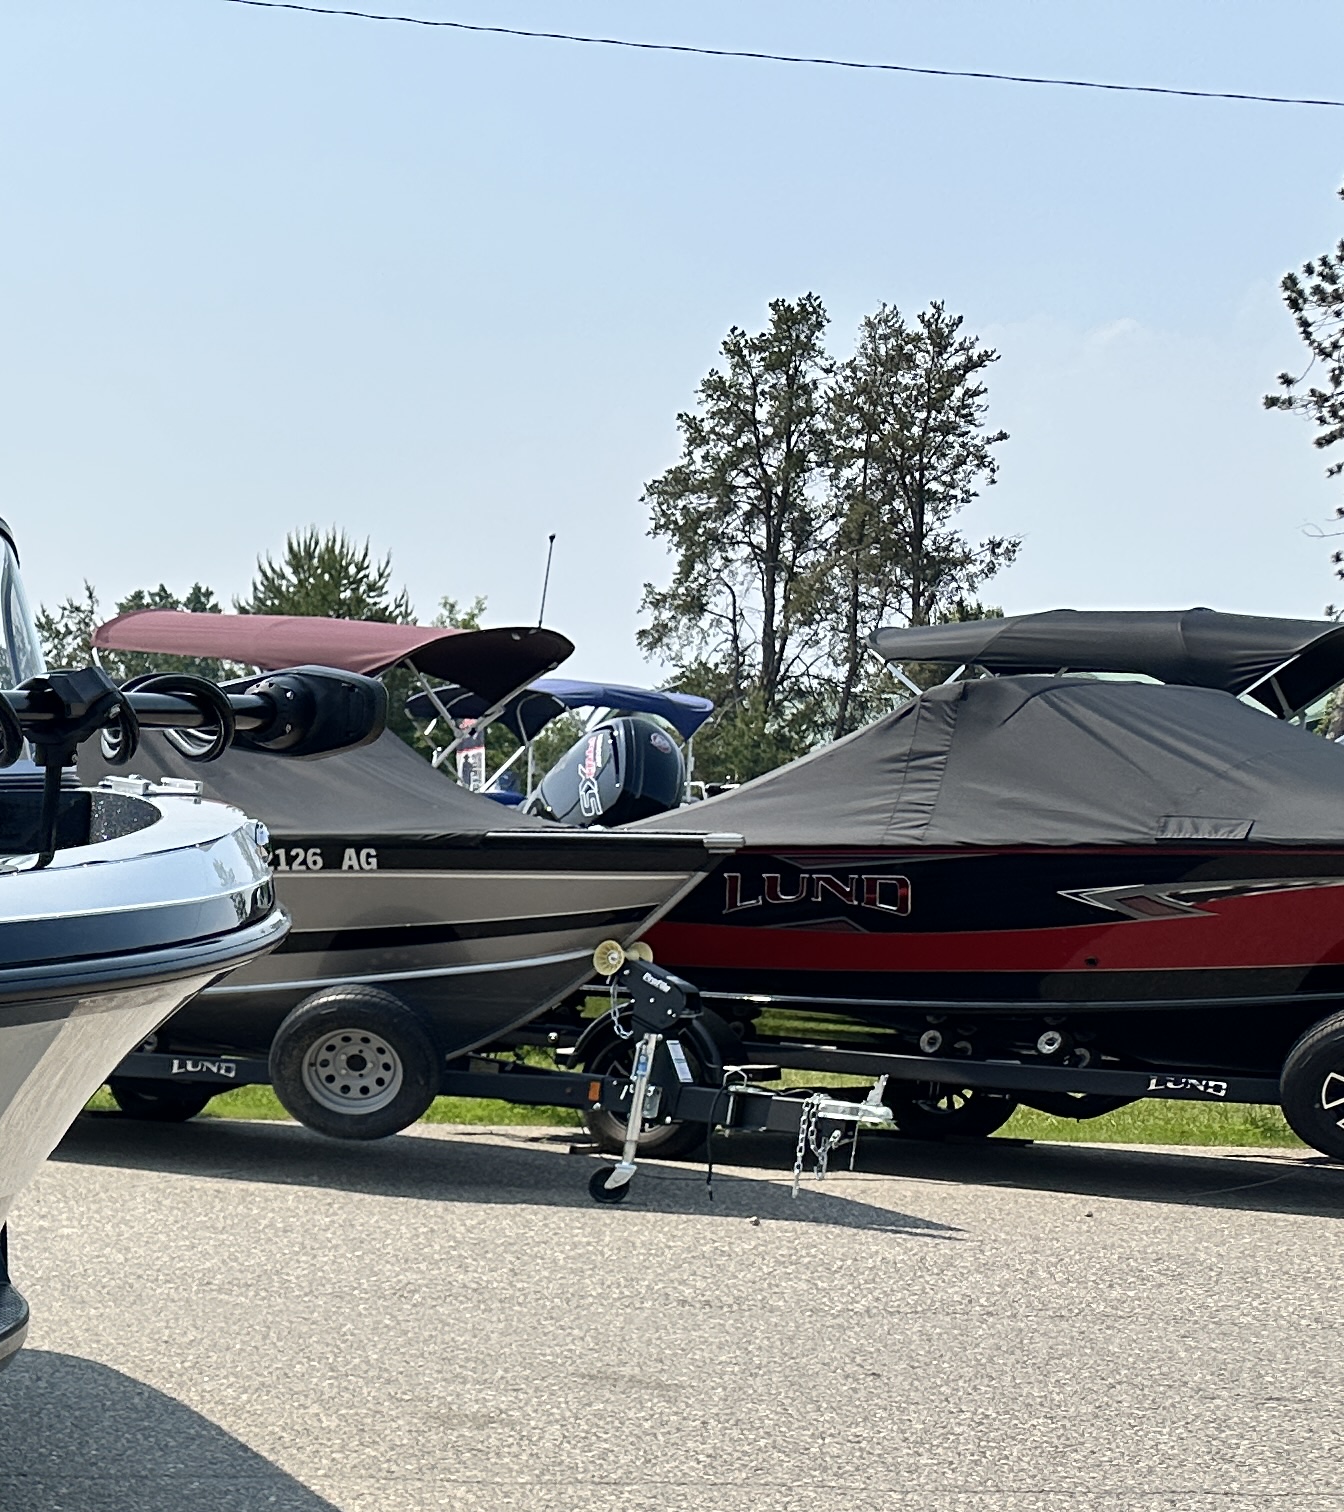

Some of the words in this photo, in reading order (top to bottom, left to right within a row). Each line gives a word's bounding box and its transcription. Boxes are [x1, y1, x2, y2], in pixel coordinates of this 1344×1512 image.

[341, 848, 378, 871] AG
[722, 872, 911, 917] LUND
[171, 1059, 236, 1078] LUND
[1147, 1075, 1228, 1097] LUND
